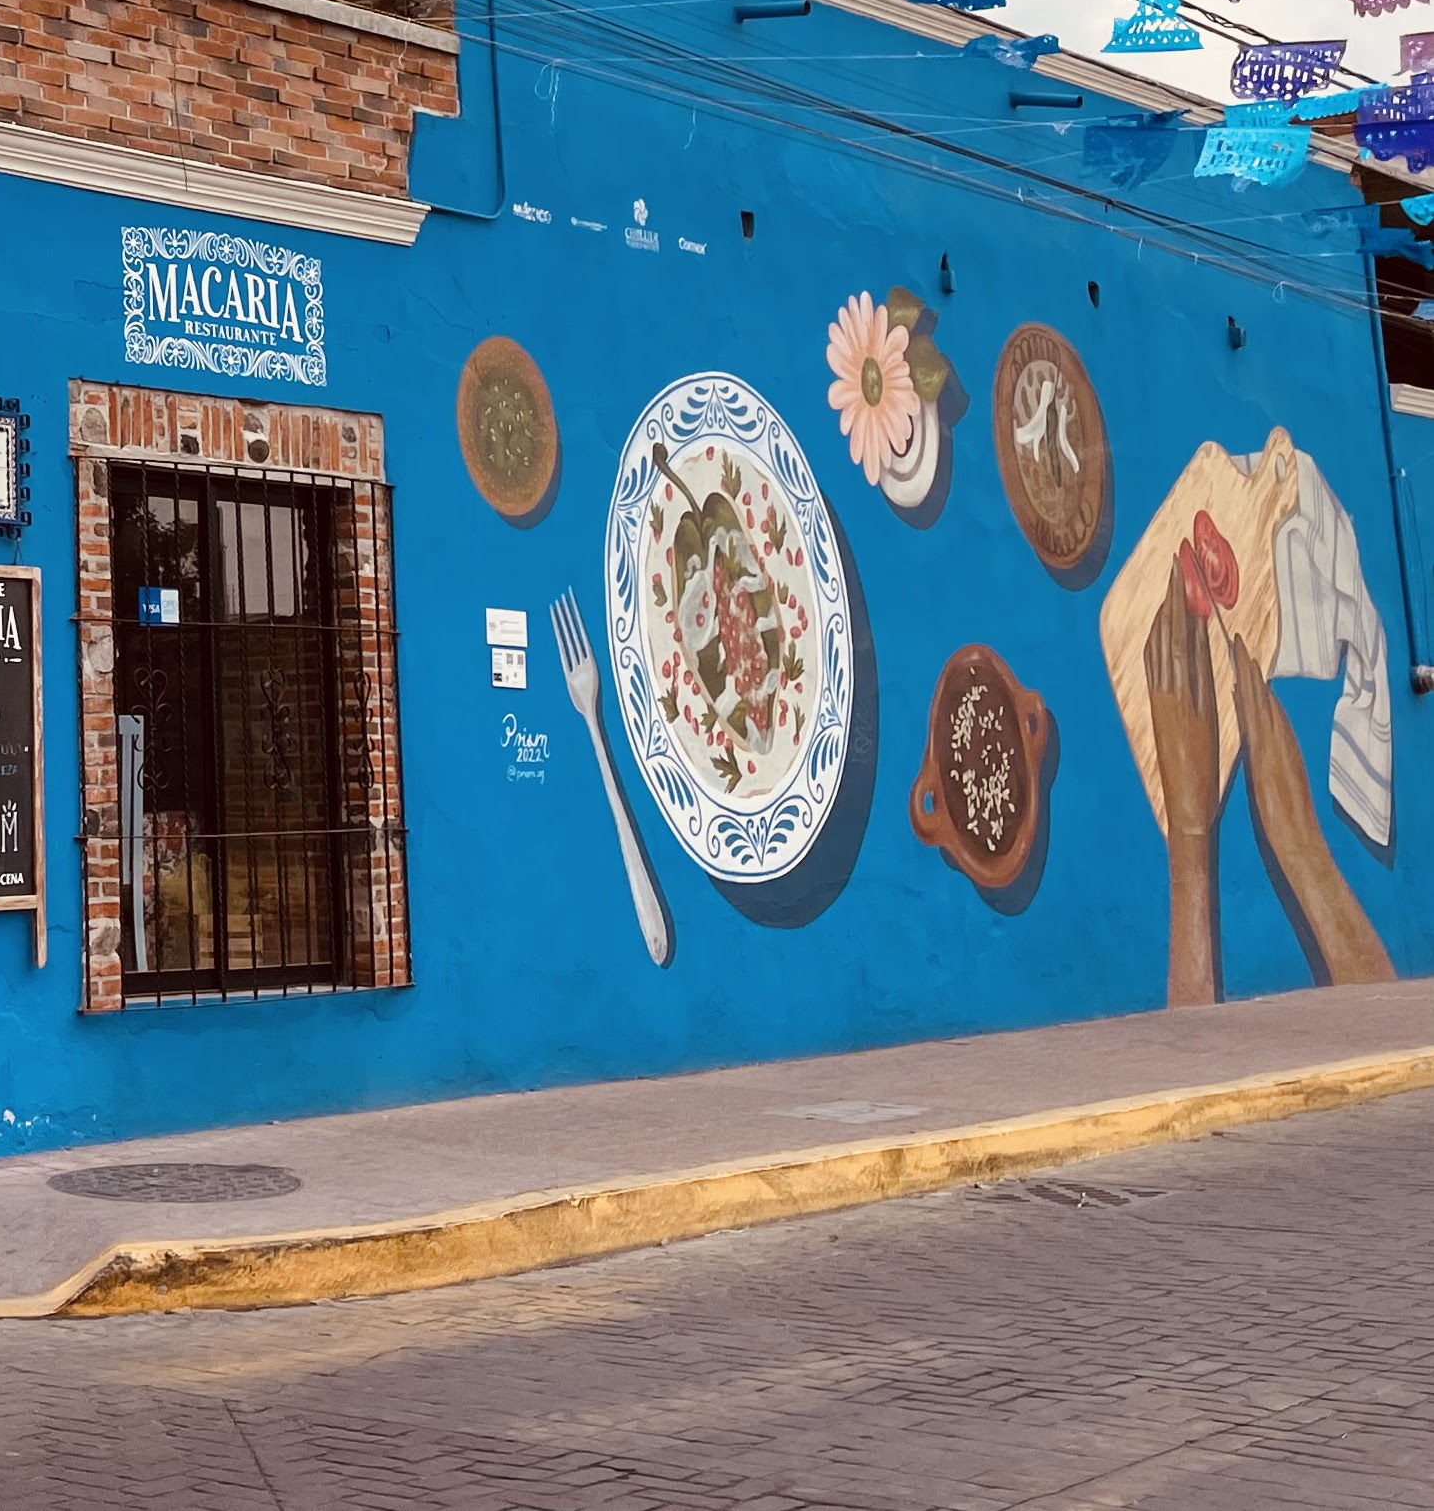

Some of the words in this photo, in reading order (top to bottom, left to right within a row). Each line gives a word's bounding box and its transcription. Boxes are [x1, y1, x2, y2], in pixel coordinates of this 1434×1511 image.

[146, 263, 304, 343] MACARIA
[184, 319, 278, 347] RESTAURANTE
[142, 603, 161, 614] VSA
[516, 747, 545, 763] 2022
